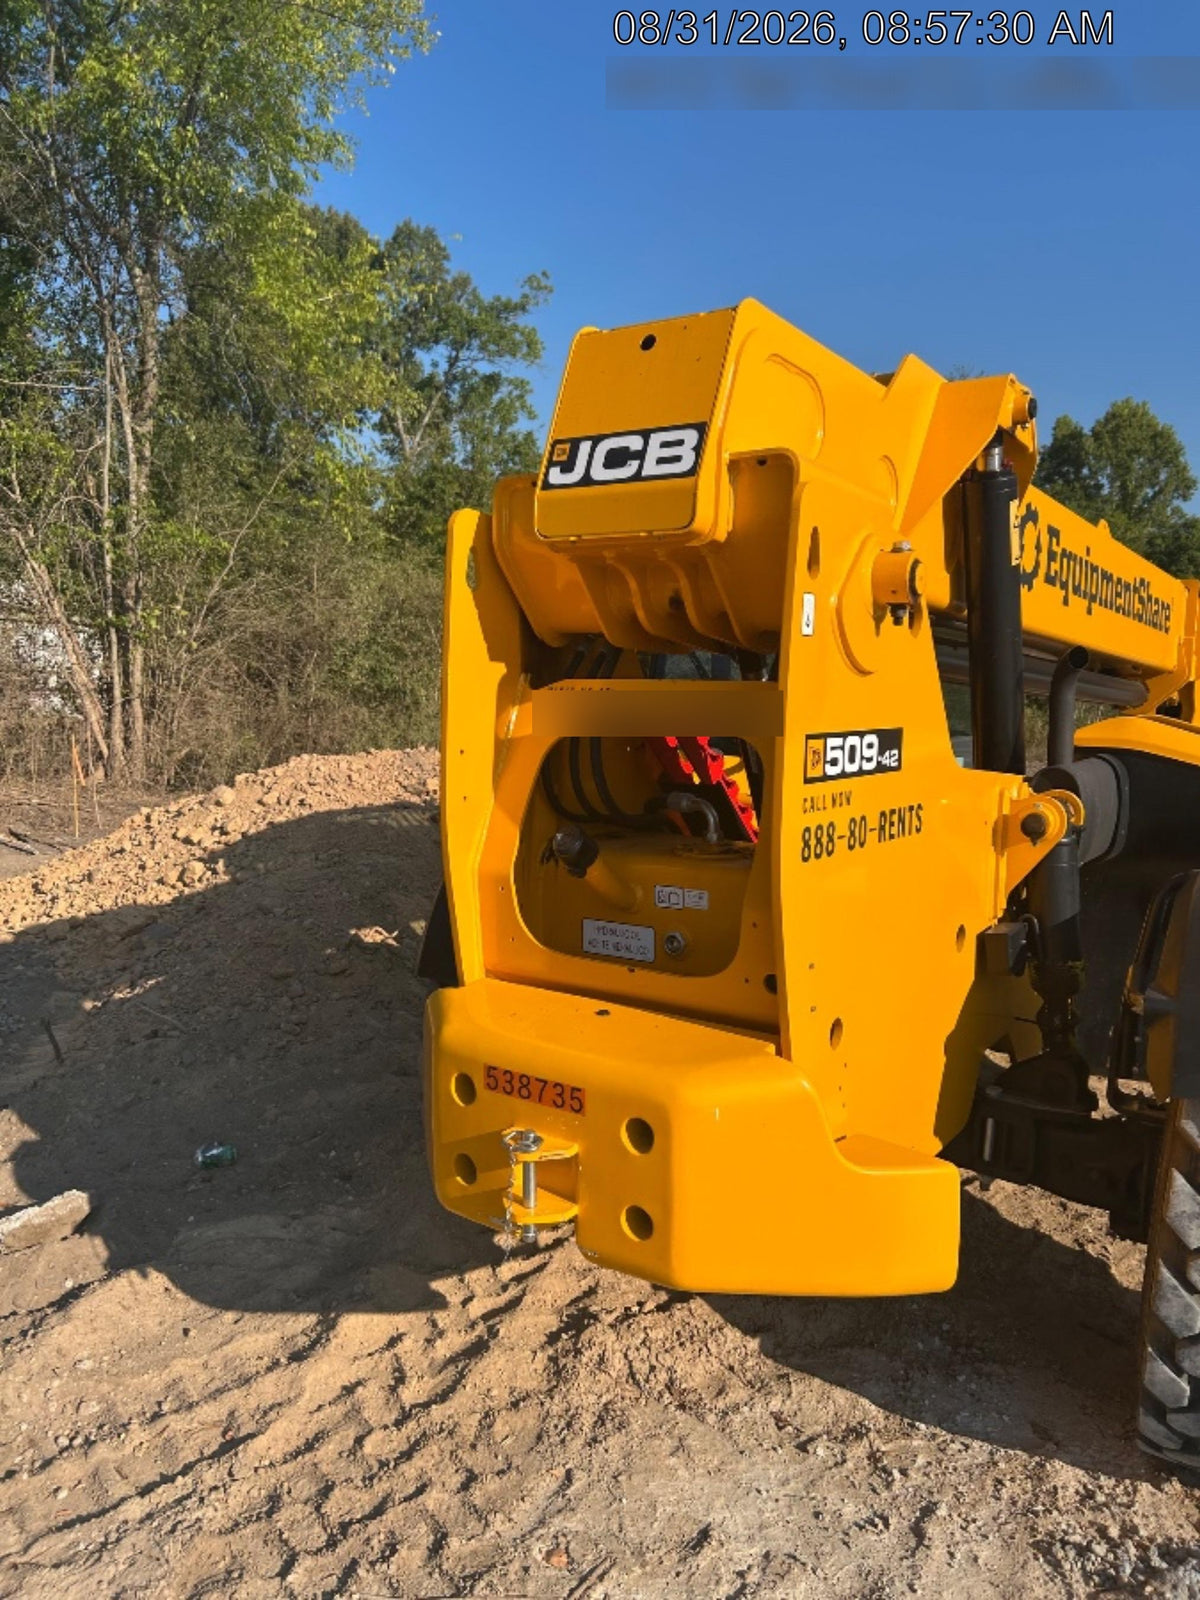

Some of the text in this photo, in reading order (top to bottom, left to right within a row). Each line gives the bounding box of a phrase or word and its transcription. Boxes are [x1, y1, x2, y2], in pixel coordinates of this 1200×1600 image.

[548, 428, 700, 485] JCB
[1044, 524, 1172, 635] EquipmentShare
[802, 790, 853, 814] CALL NOW
[801, 803, 925, 863] 888-80-RENTS
[485, 1065, 585, 1114] 538735
